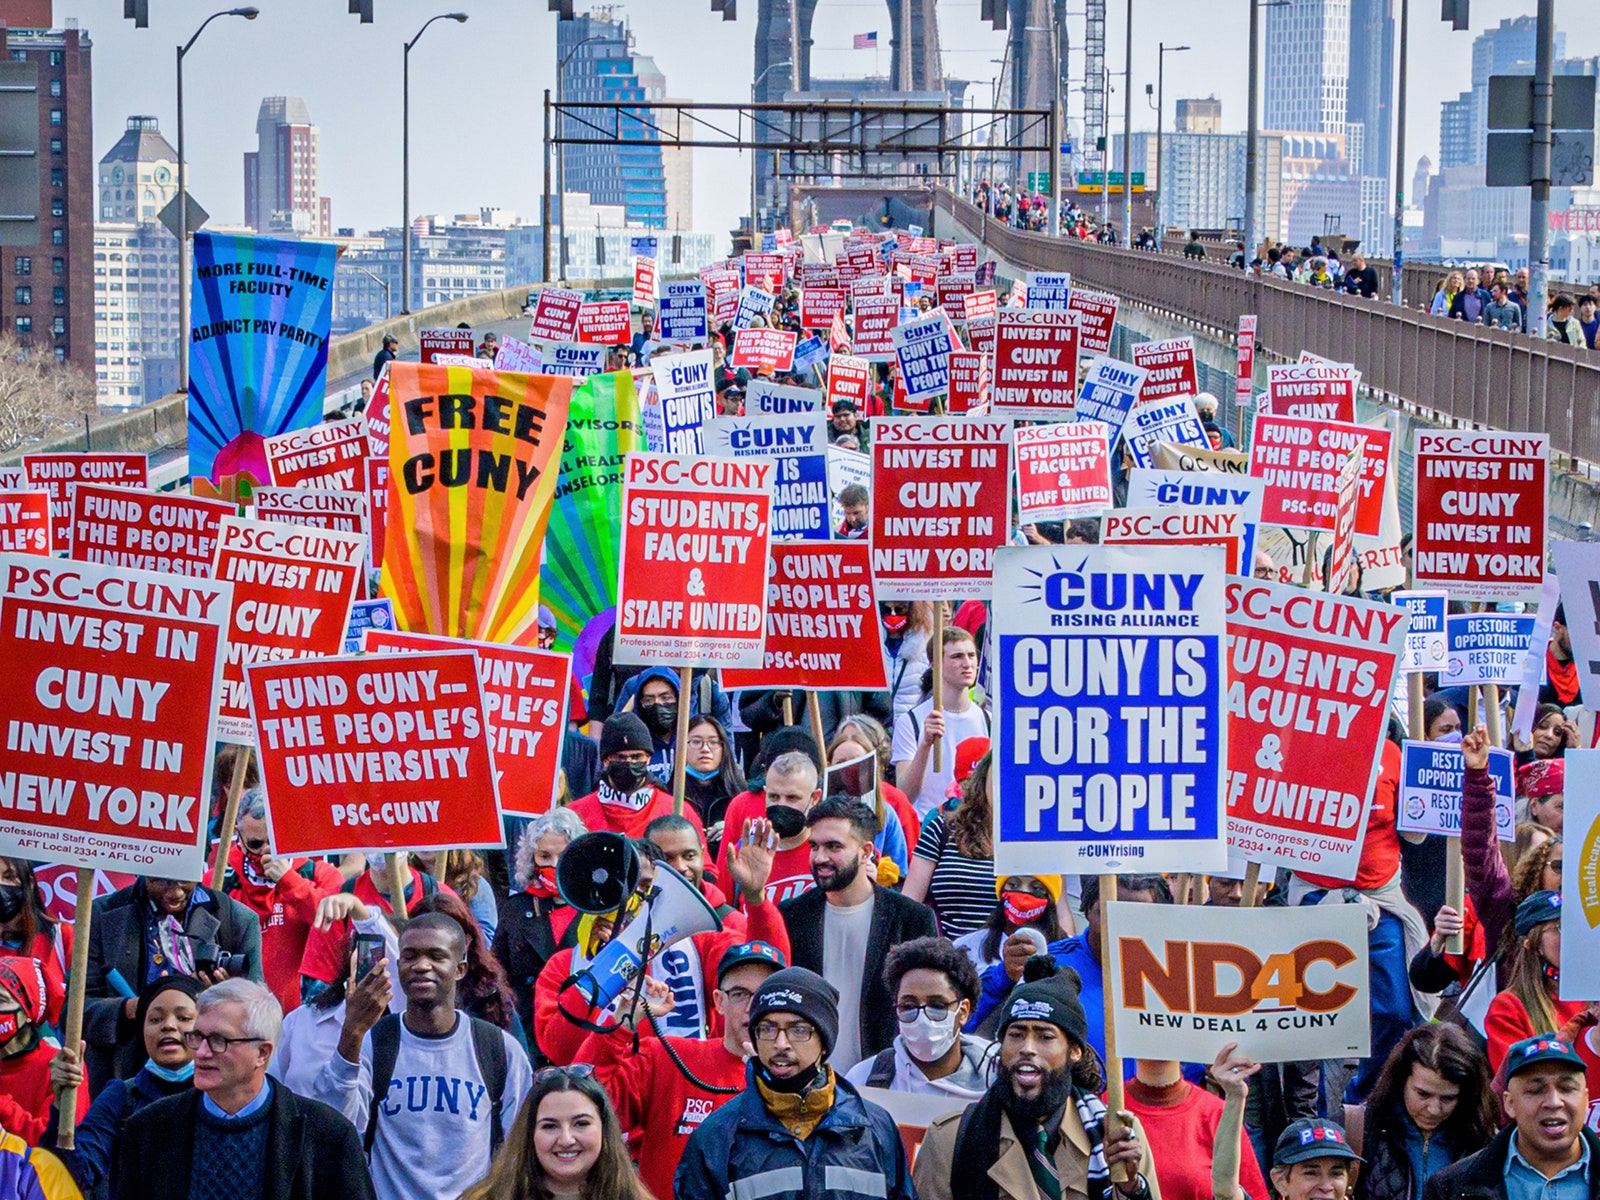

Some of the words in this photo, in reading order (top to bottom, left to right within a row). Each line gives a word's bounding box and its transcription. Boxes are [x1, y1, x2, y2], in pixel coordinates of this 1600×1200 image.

[197, 262, 243, 279] MORE
[247, 263, 329, 291] FULL-TIME
[1035, 276, 1065, 285] CUNY
[230, 281, 293, 298] FACULTY
[669, 285, 701, 294] CUNY
[1029, 288, 1055, 299] CUNY
[544, 308, 570, 319] CUNY
[863, 318, 890, 329] CUNY
[1000, 312, 1077, 325] PSC-CUNY
[192, 319, 250, 343] ADJUNCT
[254, 321, 276, 334] PAY
[279, 324, 326, 350] PARITY
[420, 330, 473, 339] PSC-CUNY
[904, 322, 942, 340] CUNY
[1002, 327, 1051, 341] INVEST
[1055, 328, 1071, 341] IN
[424, 340, 457, 349] INVEST
[459, 341, 469, 349] IN
[556, 348, 599, 360] CUNY
[740, 347, 788, 357] UNIVERSITY
[937, 336, 949, 352] IS
[1084, 337, 1108, 350] YORK
[1134, 340, 1190, 354] PSC-CUNY
[1011, 348, 1062, 365] CUNY
[1138, 353, 1175, 366] INVEST
[1177, 351, 1189, 361] IN
[671, 363, 708, 386] CUNY
[905, 359, 930, 377] FOR
[1002, 370, 1049, 382] INVEST
[1052, 370, 1068, 382] IN
[1147, 366, 1184, 382] CUNY
[1271, 368, 1350, 380] PSC-CUNY
[995, 388, 1029, 402] NEW
[1032, 389, 1074, 405] YORK
[1143, 383, 1177, 396] INVEST
[1179, 381, 1191, 391] IN
[1277, 383, 1327, 397] INVEST
[1331, 383, 1346, 395] IN
[404, 394, 547, 446] FREE
[269, 422, 362, 456] PSC-CUNY
[730, 424, 816, 448] CUNY
[876, 423, 1008, 442] PSC-CUNY
[1017, 424, 1104, 441] PSC-CUNY
[1262, 424, 1312, 445] FUND
[734, 448, 768, 456] RISING
[771, 445, 814, 454] ALLIANCE
[1019, 441, 1105, 460] STUDENTS,
[1256, 445, 1291, 466] THE
[1420, 436, 1543, 457] PSC-CUNY
[277, 446, 336, 474] INVEST
[341, 441, 361, 458] IN
[883, 448, 964, 469] INVEST
[971, 449, 996, 468] IN
[1030, 456, 1097, 474] FACULTY
[31, 462, 76, 478] FUND
[402, 448, 540, 501] CUNY
[629, 458, 770, 489] PSC-CUNY
[1058, 473, 1072, 487] &
[1426, 460, 1502, 480] INVEST
[1509, 462, 1534, 481] IN
[258, 492, 357, 512] PSC-CUNY
[898, 481, 982, 509] CUNY
[1022, 490, 1058, 507] STAFF
[1061, 486, 1108, 502] UNITED
[1440, 491, 1520, 517] CUNY
[84, 496, 142, 522] FUND
[629, 497, 767, 537] STUDENTS,
[77, 521, 118, 546] THE
[884, 517, 961, 537] INVEST
[968, 517, 993, 537] IN
[1106, 514, 1238, 537] PSC-CUNY
[1427, 522, 1500, 543] INVEST
[1507, 526, 1531, 544] IN
[224, 525, 359, 563] PSC-CUNY
[644, 532, 752, 564] FACULTY
[874, 548, 930, 573] NEW
[1418, 551, 1470, 575] NEW
[1474, 554, 1541, 577] YORK
[226, 557, 312, 589] INVEST
[315, 566, 343, 594] IN
[686, 567, 705, 596] &
[6, 565, 221, 619] PSC-CUNY
[1045, 572, 1204, 612] CUNY
[235, 600, 322, 639] CUNY
[623, 600, 684, 629] STAFF
[689, 602, 761, 633] UNITED
[1051, 614, 1116, 628] RISING
[1120, 614, 1200, 628] ALLIANCE
[1468, 620, 1517, 633] RESTORE
[15, 608, 144, 655] INVEST
[155, 627, 199, 662] IN
[620, 638, 671, 647] Professional
[674, 640, 692, 648] Staff
[695, 641, 731, 650] Congress
[737, 642, 760, 650] CUNY
[1455, 634, 1531, 649] OPPORTUNITY
[660, 650, 682, 658] Local
[726, 652, 740, 660] CIO
[765, 651, 841, 670] PSC-CUNY
[1469, 652, 1517, 665] RESTORE
[1013, 638, 1149, 698] CUNY
[1158, 638, 1207, 697] IS
[1479, 666, 1507, 679] SUNY
[35, 667, 171, 722] CUNY
[264, 675, 349, 711] FUND
[262, 715, 329, 750] THE
[335, 707, 481, 745] PEOPLE'S
[1014, 705, 1110, 765] FOR
[1120, 706, 1207, 764] THE
[7, 720, 131, 765] INVEST
[140, 739, 183, 773] IN
[1255, 733, 1284, 772] &
[285, 747, 470, 787] UNIVERSITY
[0, 771, 76, 816] NEW
[84, 782, 197, 834] YORK
[1024, 774, 1196, 833] PEOPLE
[1253, 777, 1360, 829] UNITED
[331, 800, 440, 827] PSC-CUNY
[62, 833, 85, 844] Staff
[88, 837, 140, 853] Congress
[150, 846, 182, 856] CUNY
[1227, 821, 1253, 835] Staff
[1255, 828, 1309, 847] Congress
[1319, 839, 1353, 854] CUNY
[18, 838, 40, 848] AFT
[43, 842, 71, 853] Local
[74, 846, 97, 857] 2334
[108, 852, 130, 862] AFL
[134, 854, 154, 864] CIO
[1077, 844, 1144, 858] #CUNYrising
[1238, 838, 1263, 852] 2334
[1274, 846, 1296, 858] AFL
[1300, 850, 1321, 862] CIO
[1118, 937, 1358, 1016] ND4C
[1139, 1012, 1183, 1028] NEW
[1193, 1018, 1246, 1032] DEAL
[1256, 1018, 1268, 1031] 4
[1277, 1013, 1338, 1030] CUNY
[385, 1075, 486, 1121] CUNY
[686, 1098, 713, 1114] PSC
